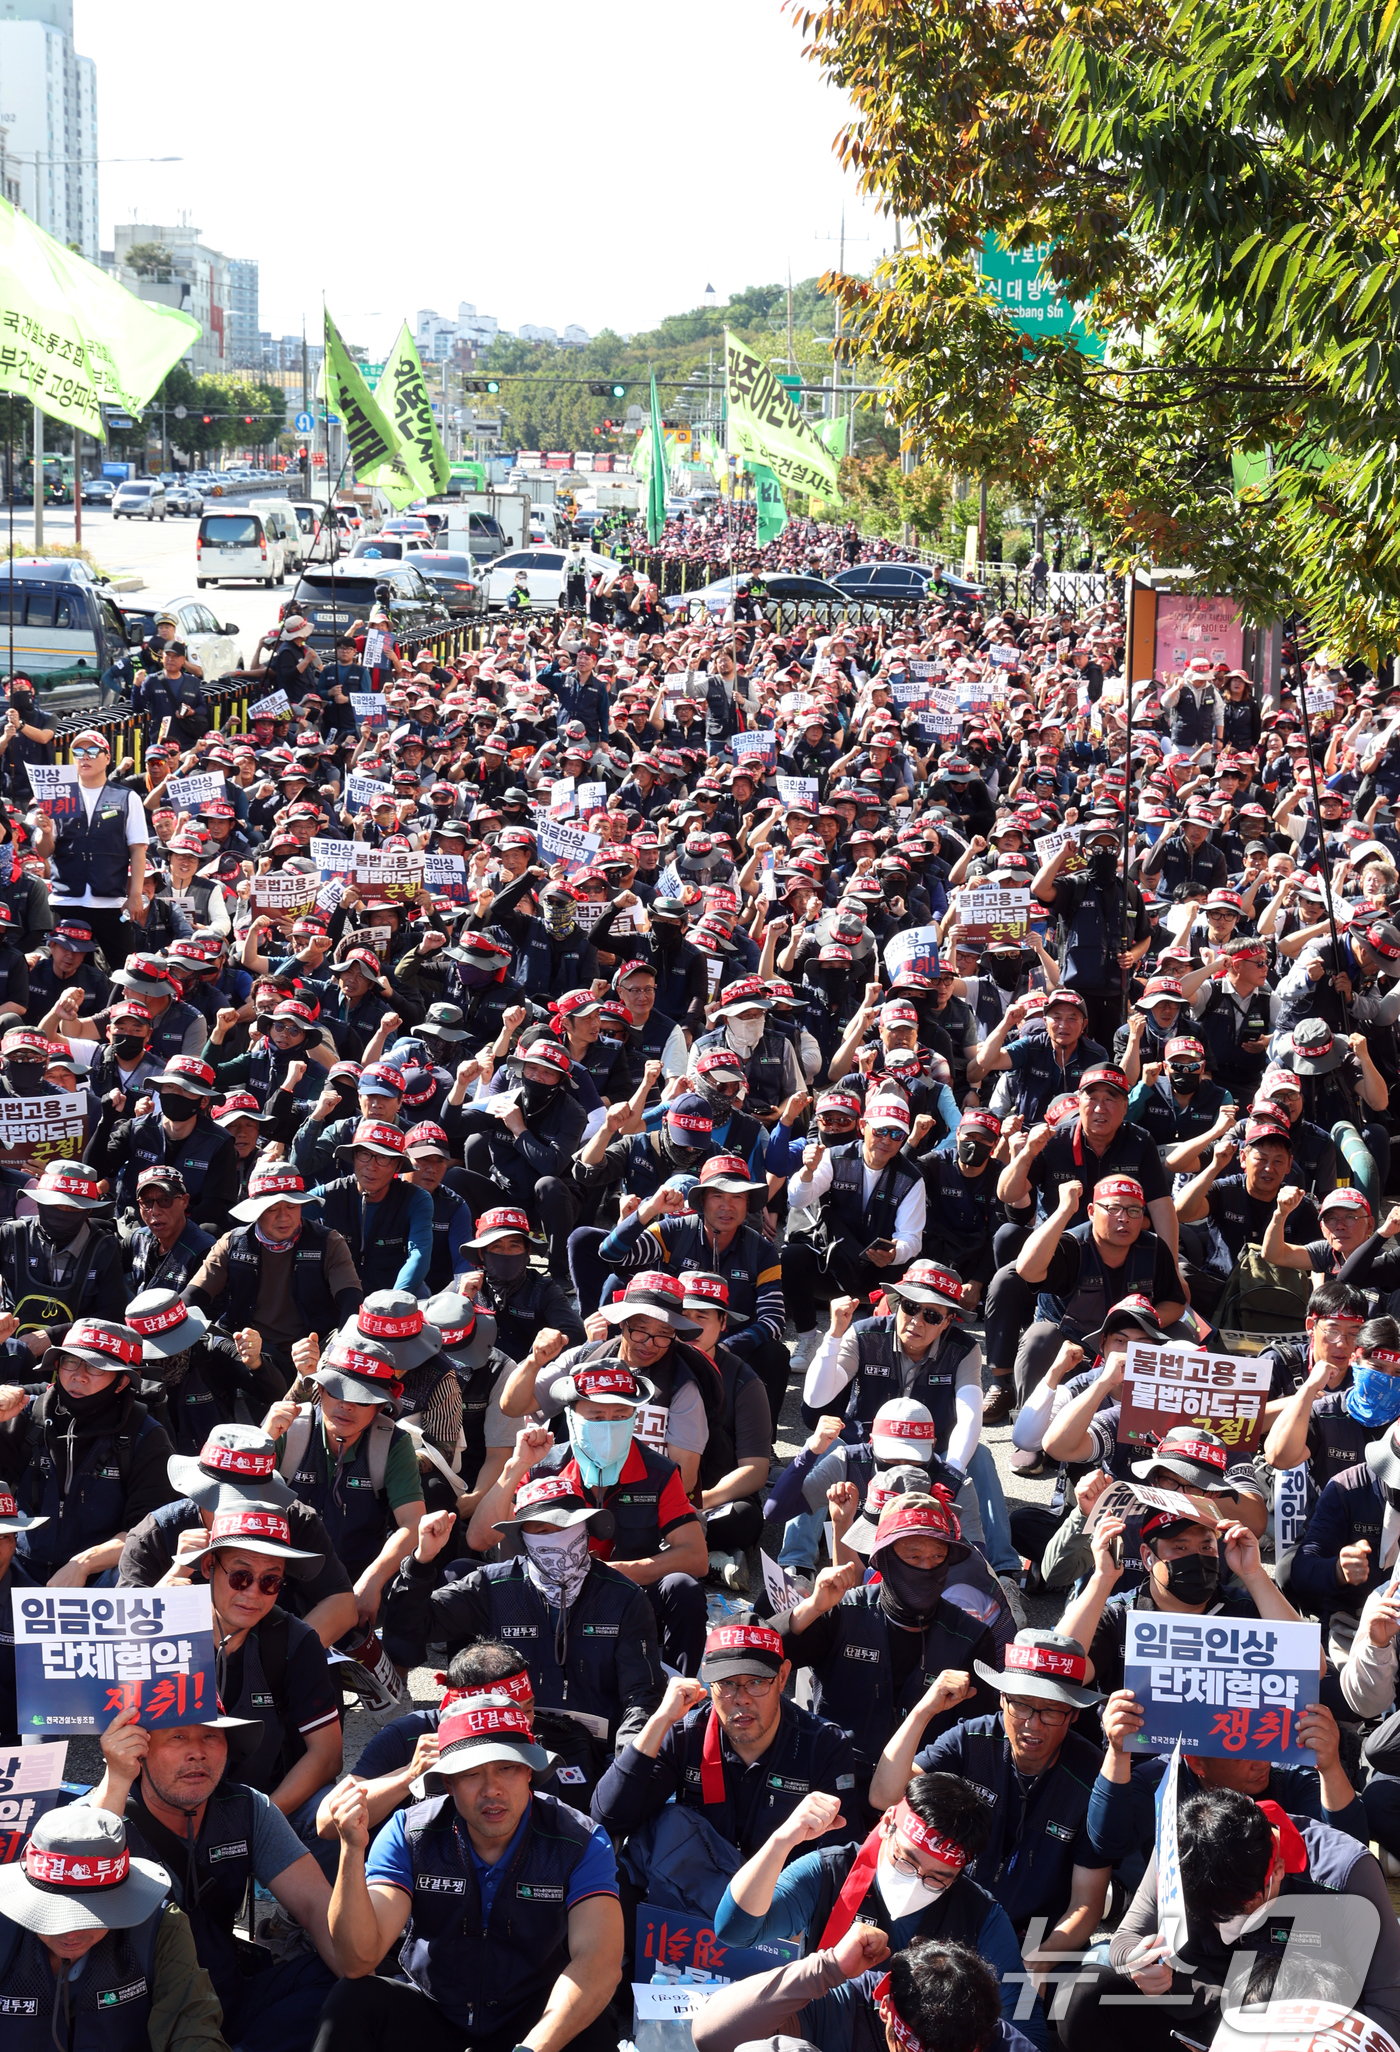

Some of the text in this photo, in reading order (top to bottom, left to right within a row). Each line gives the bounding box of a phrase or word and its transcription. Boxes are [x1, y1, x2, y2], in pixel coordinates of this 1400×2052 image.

[1046, 304, 1064, 319] Stn
[169, 775, 213, 797] 임금인상
[539, 822, 586, 847] 임금인상
[355, 853, 408, 868] 불법고용
[254, 877, 307, 892] 불법고용
[356, 868, 423, 884] 불법하도급
[255, 889, 317, 908] 불법하도급
[385, 881, 422, 900] 근절!
[959, 892, 1012, 908] 불법고용
[960, 908, 1028, 925] 불법하도급
[989, 921, 1027, 941] 근절!
[0, 1100, 62, 1121] 법고용
[30, 1136, 83, 1163] 근절!
[231, 1251, 259, 1264] 단결투쟁
[1132, 1348, 1237, 1387] 불법고용
[1131, 1382, 1261, 1420] 불법하도급
[1354, 1524, 1381, 1534] 단결투쟁
[21, 1597, 166, 1636] 임금인상
[502, 1627, 537, 1637] 단결투쟁
[846, 1646, 878, 1660] 단결투쟁
[1134, 1622, 1278, 1667] 임금인상
[42, 1640, 193, 1681] 단체협약
[103, 1671, 206, 1725] 쟁취!
[1150, 1665, 1300, 1712] 단체협약
[46, 1715, 95, 1726] 전국건설노동조합
[419, 1876, 465, 1893] 단결투쟁
[0, 1998, 36, 2013] 결투쟁
